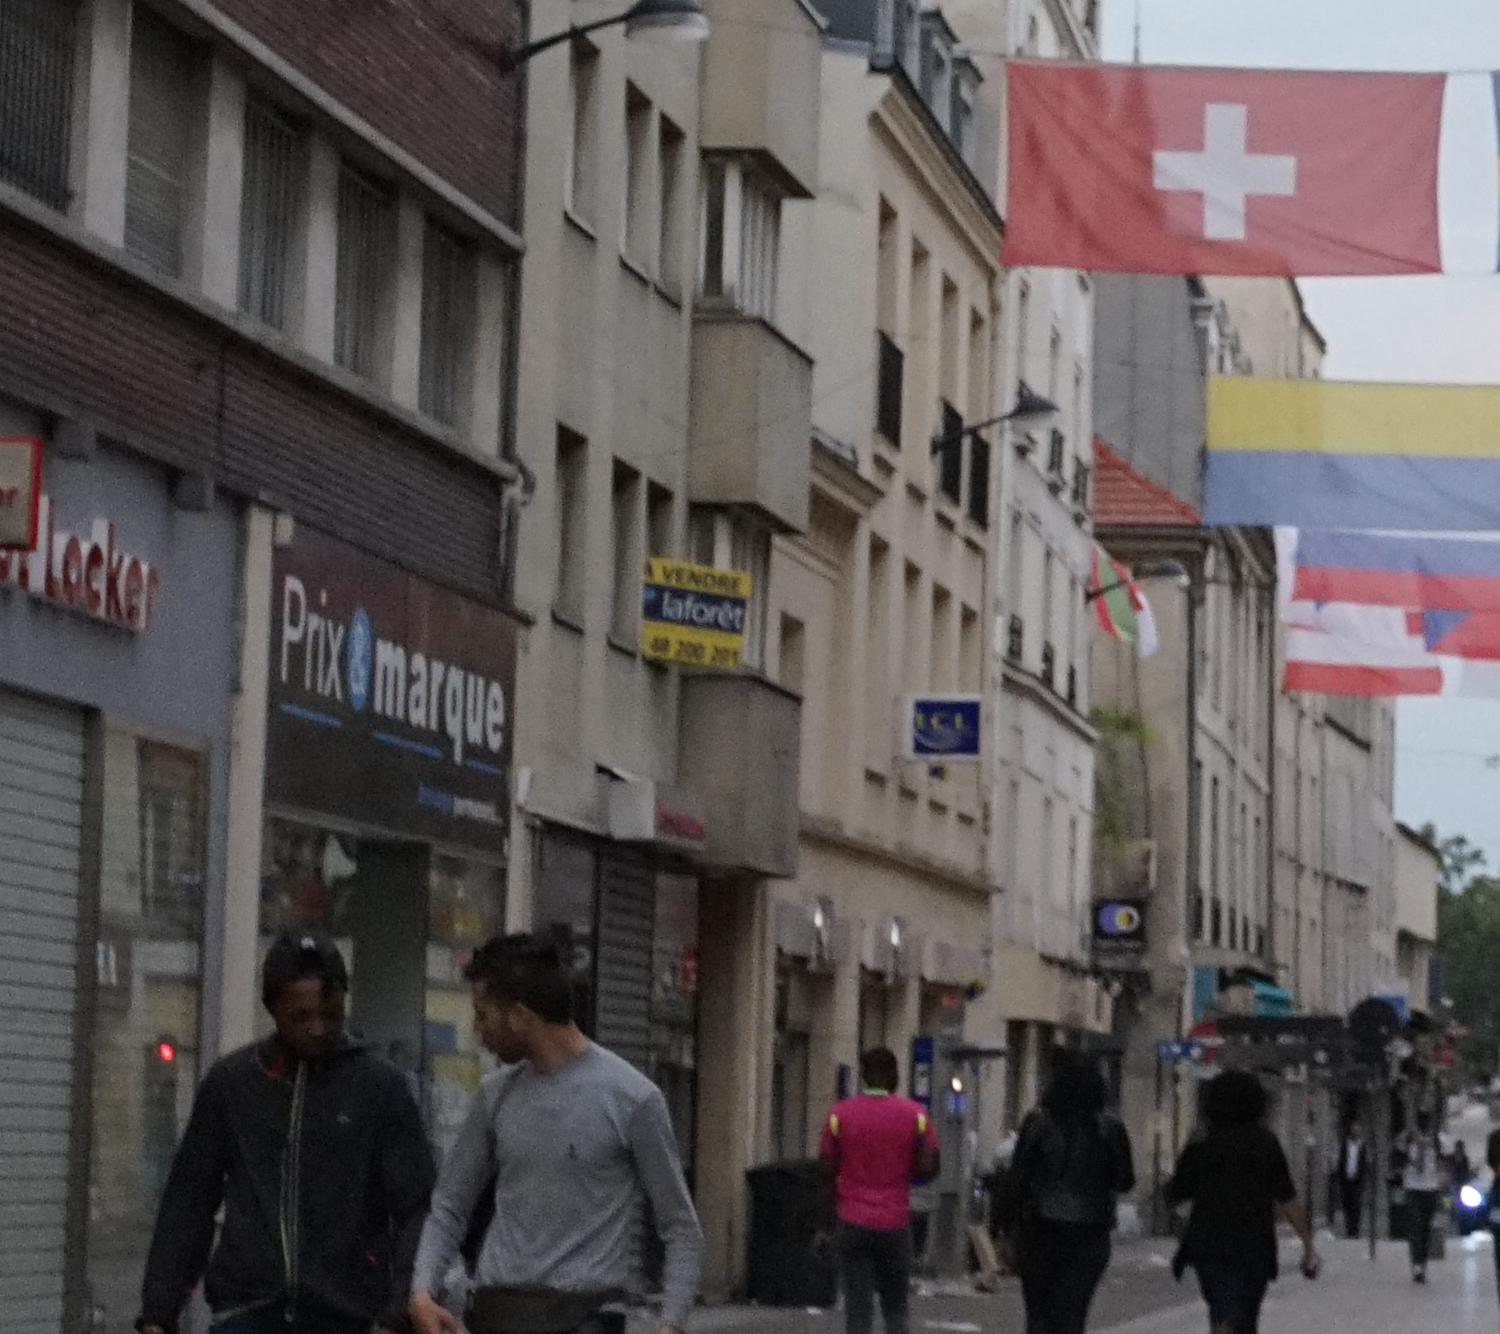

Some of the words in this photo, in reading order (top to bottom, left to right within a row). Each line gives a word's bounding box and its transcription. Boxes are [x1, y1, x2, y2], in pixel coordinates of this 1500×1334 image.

[38, 493, 160, 632] Locker
[661, 564, 741, 591] VENDRE
[661, 590, 742, 630] laforêt
[279, 572, 346, 702] Prix
[372, 636, 506, 766] marque
